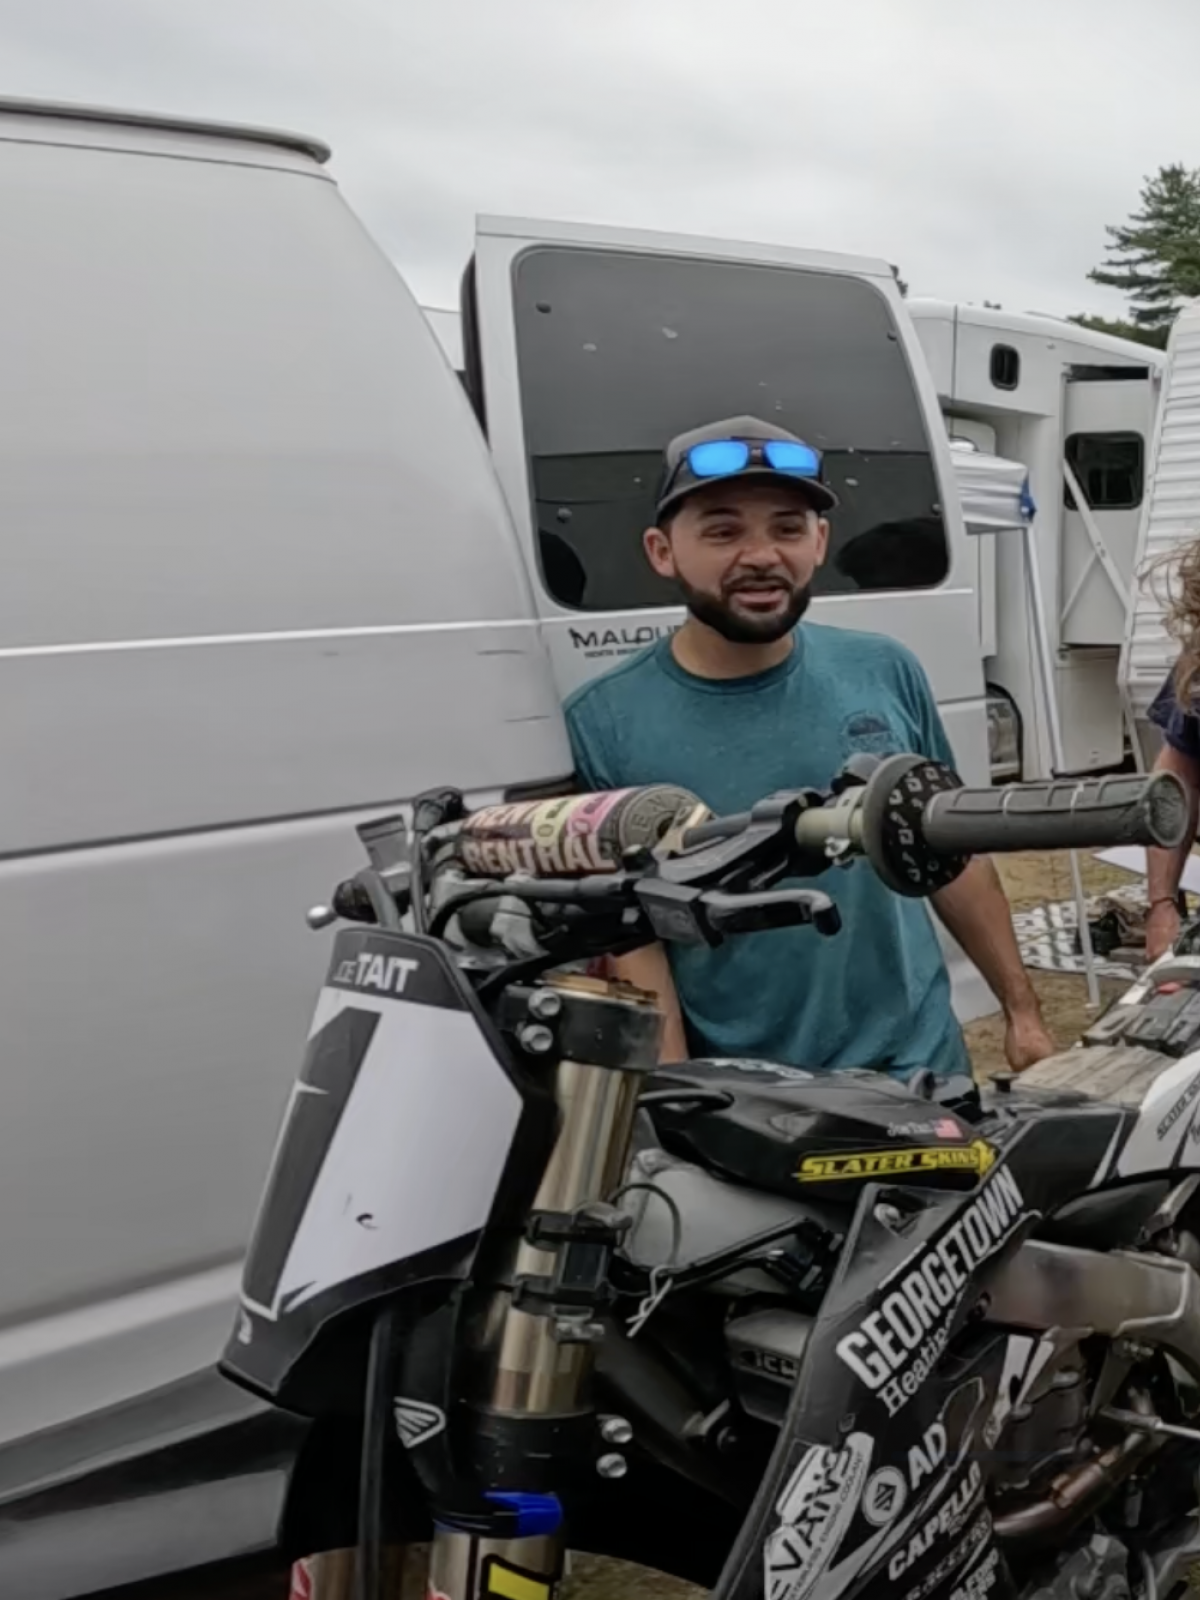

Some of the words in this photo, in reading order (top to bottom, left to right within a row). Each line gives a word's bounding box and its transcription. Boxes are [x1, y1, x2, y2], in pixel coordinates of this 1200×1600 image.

[462, 829, 618, 874] RENTHAL
[354, 952, 421, 994] TAIT
[801, 1152, 915, 1176] SLATER
[920, 1150, 980, 1169] SKINS
[835, 1163, 1024, 1389] GEORGETOWN
[907, 1423, 948, 1491] AD
